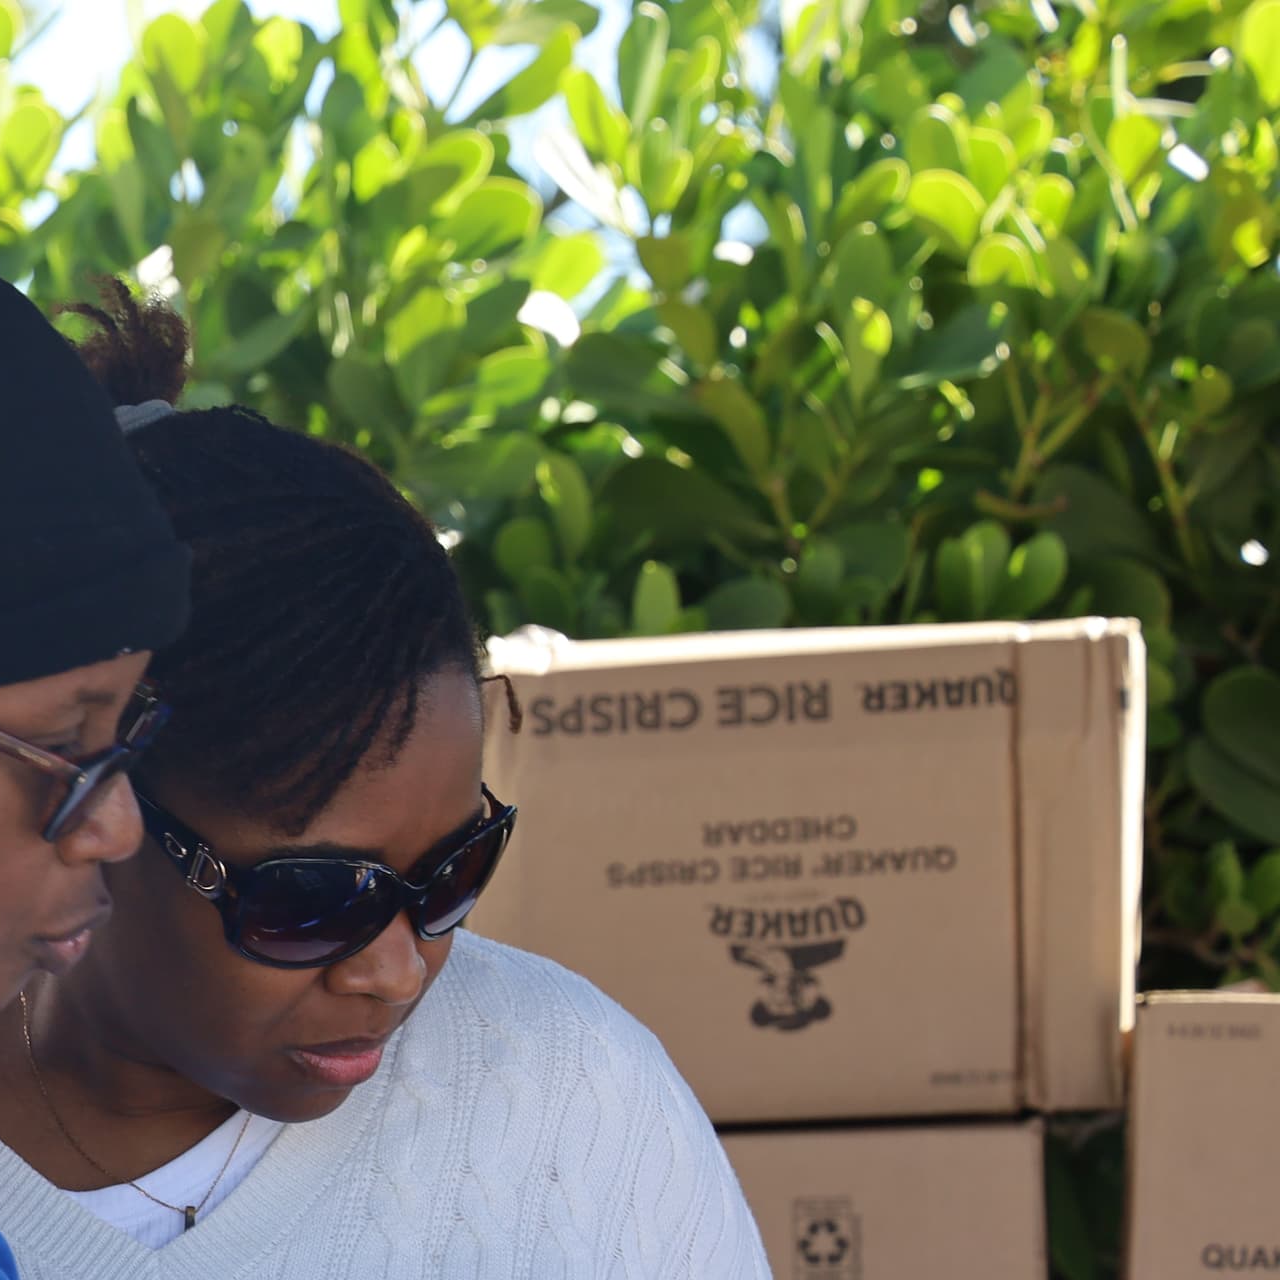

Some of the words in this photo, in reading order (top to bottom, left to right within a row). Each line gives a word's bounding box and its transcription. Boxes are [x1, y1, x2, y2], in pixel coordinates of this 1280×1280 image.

[717, 678, 829, 726] RICE
[860, 667, 1018, 713] QUAKER
[530, 687, 702, 737] CRISPS
[702, 814, 858, 847] CHEDDAR
[606, 857, 720, 889] CRISPS
[730, 854, 802, 882] RICE
[814, 844, 958, 878] QUAKER
[709, 897, 867, 940] QUAKER
